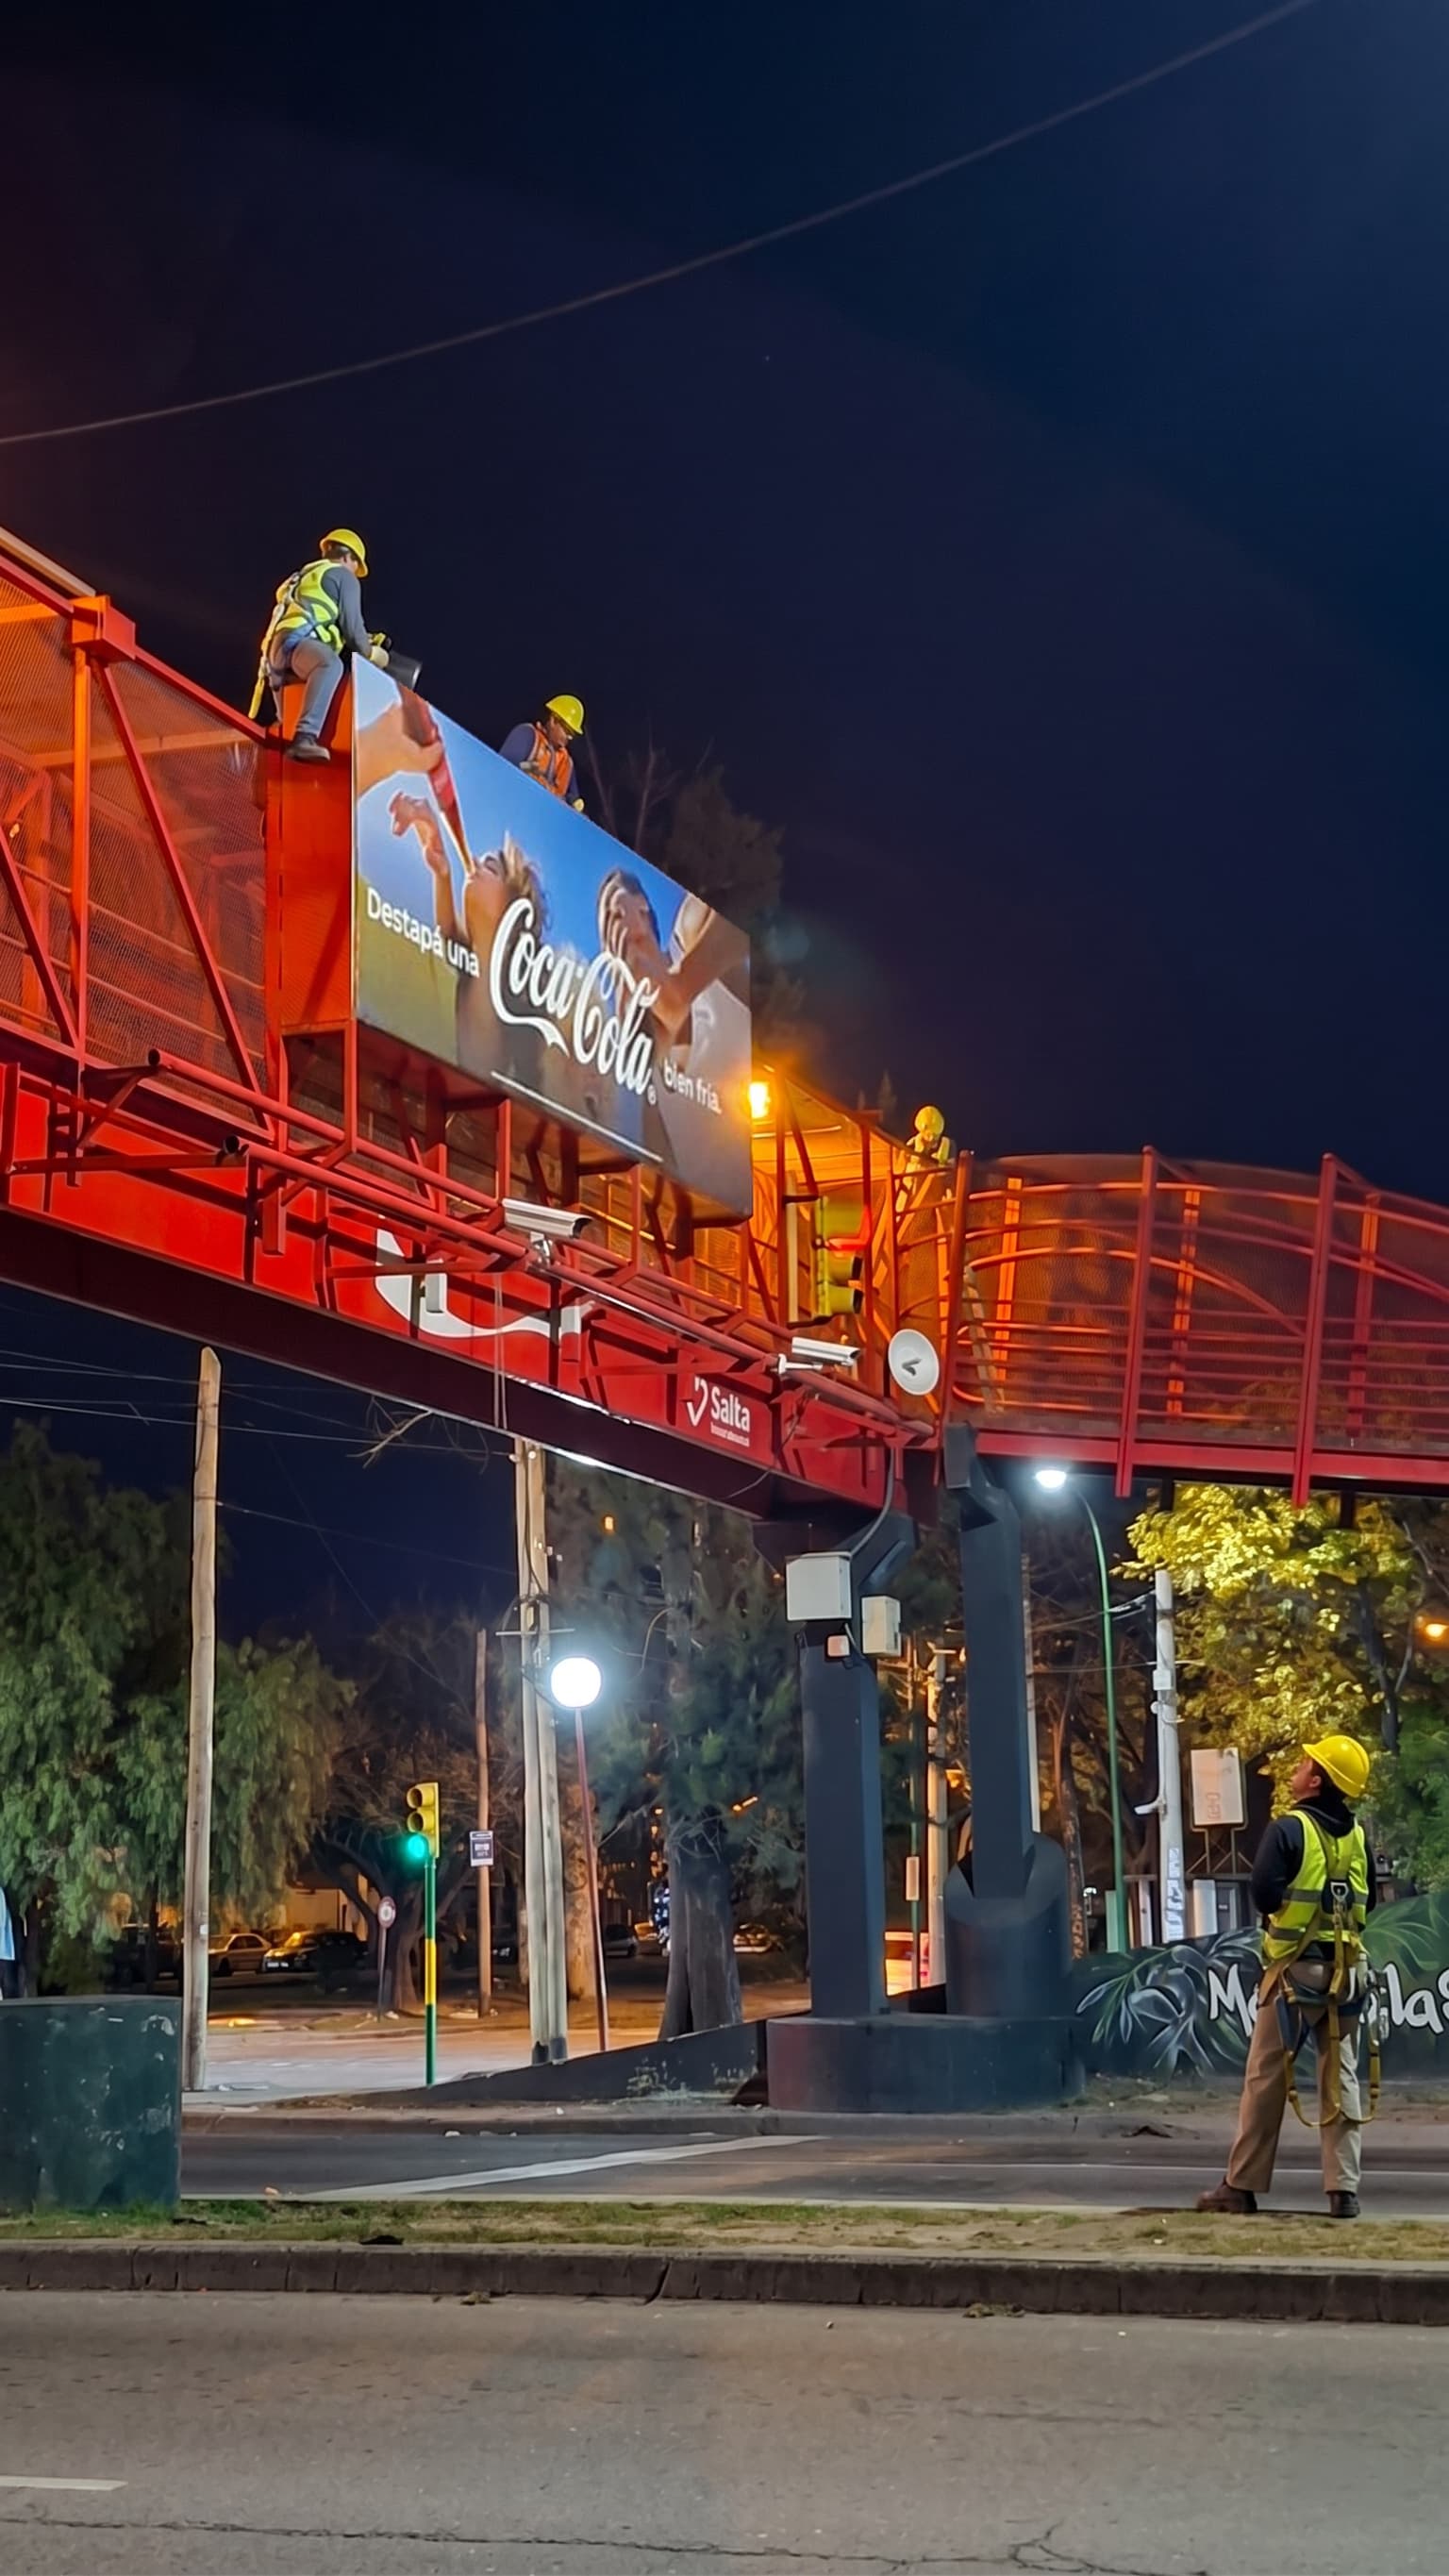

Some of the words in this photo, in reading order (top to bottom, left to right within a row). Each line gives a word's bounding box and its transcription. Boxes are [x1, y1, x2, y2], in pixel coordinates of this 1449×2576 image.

[367, 886, 443, 959] Destapá
[447, 938, 480, 979] una
[663, 1057, 693, 1101] bien
[711, 1386, 750, 1432] Salta
